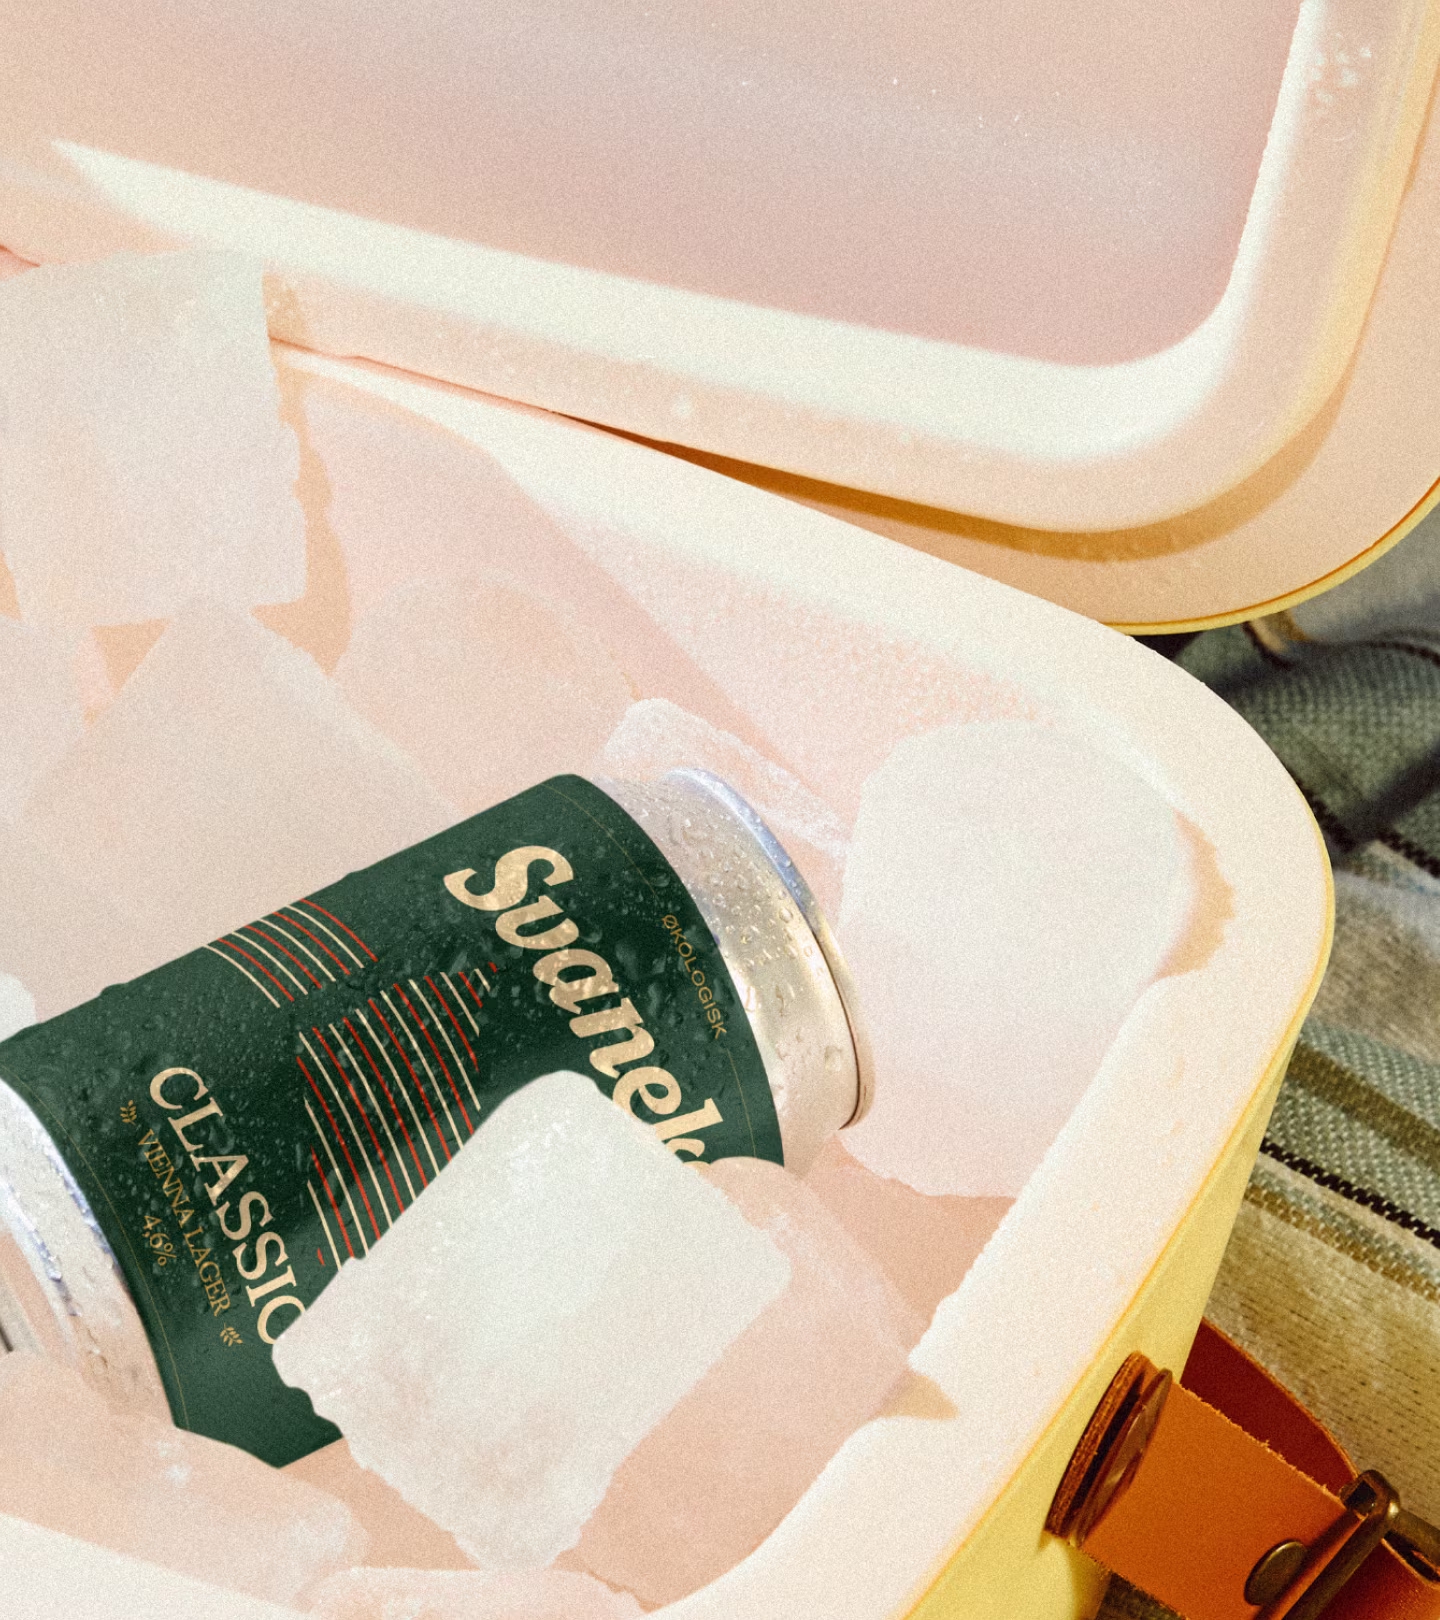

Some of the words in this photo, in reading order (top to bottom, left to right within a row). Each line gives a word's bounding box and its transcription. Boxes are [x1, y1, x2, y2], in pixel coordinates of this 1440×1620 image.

[443, 846, 722, 1175] Svanek
[661, 914, 727, 1040] ØKOLOGISK
[138, 1129, 195, 1227] VIENNA
[183, 1225, 231, 1316] LAGER
[142, 1214, 177, 1267] 4,6%
[149, 1066, 306, 1345] CLASSIC
